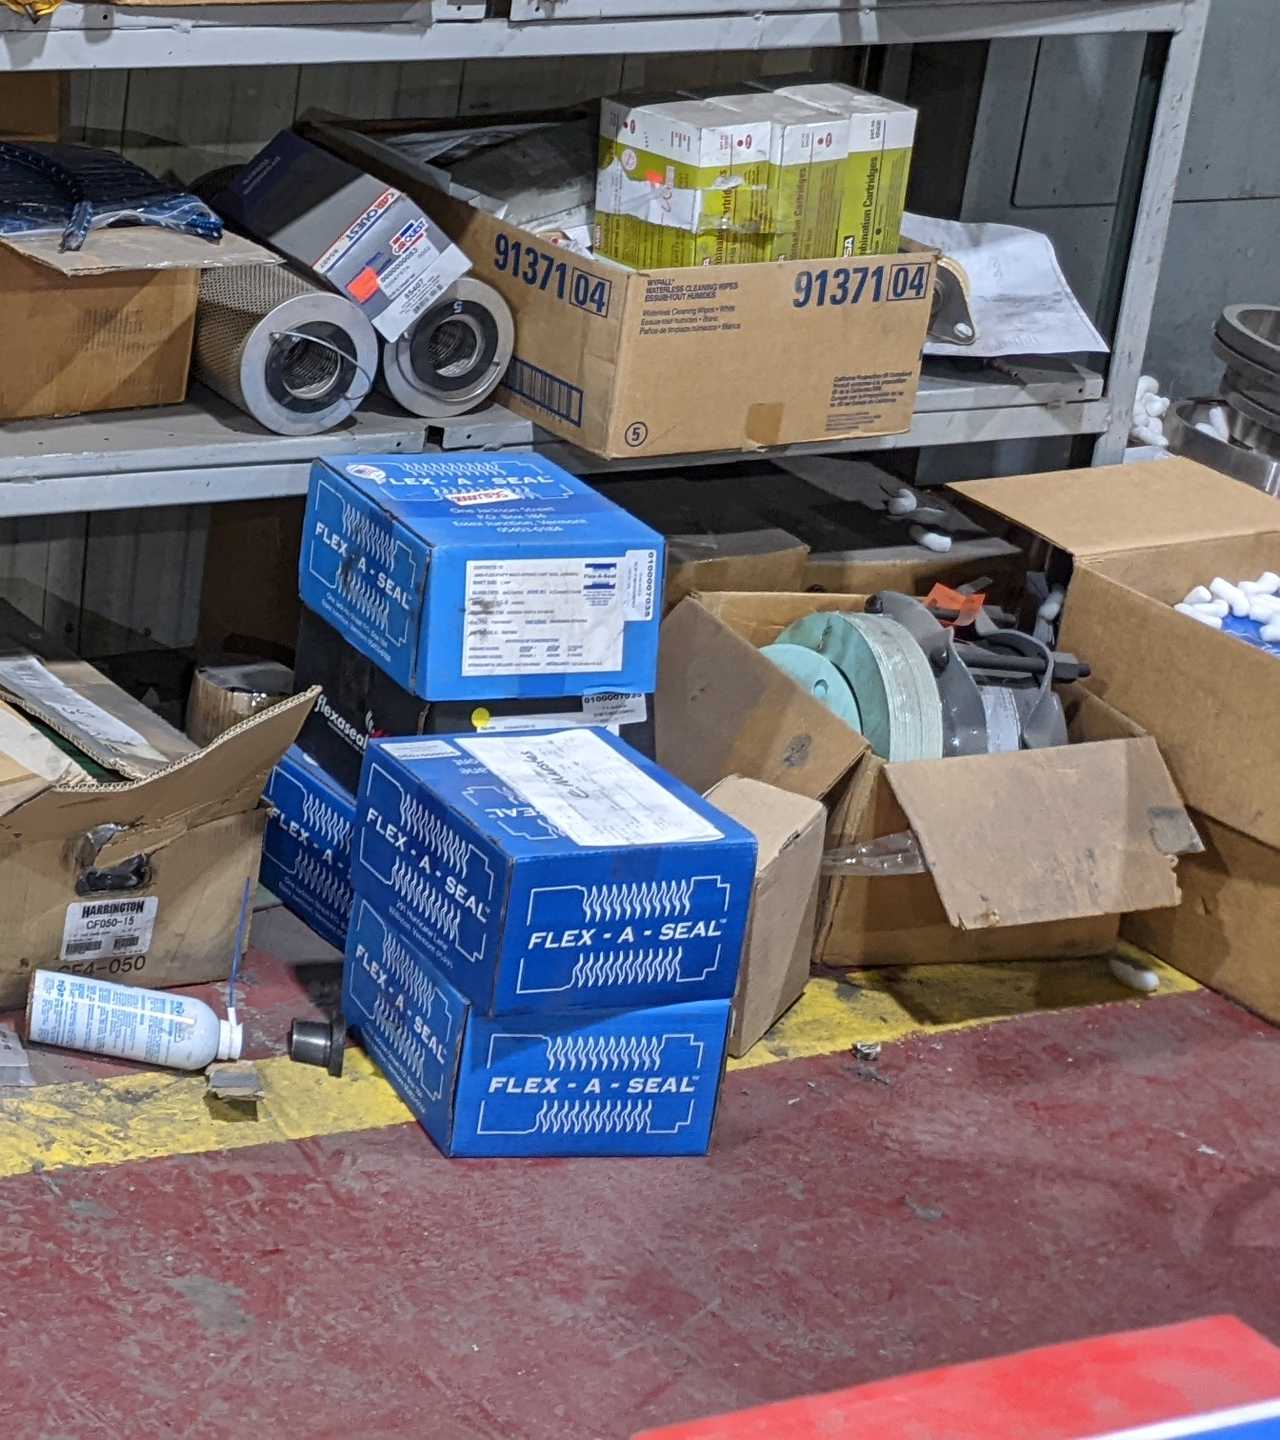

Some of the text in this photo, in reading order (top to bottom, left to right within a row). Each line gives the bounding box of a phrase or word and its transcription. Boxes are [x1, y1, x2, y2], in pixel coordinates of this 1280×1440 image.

[494, 232, 567, 299] 91371
[573, 271, 606, 314] 04
[792, 265, 925, 309] 91371 04
[630, 426, 642, 442] 5
[387, 476, 441, 486] LEX
[493, 475, 554, 486] SEAL
[315, 521, 348, 558] FLEX
[376, 575, 411, 610] SEAL
[366, 808, 409, 849] FLEX
[444, 876, 487, 923] SEAL
[81, 900, 145, 919] HARRINGTON
[528, 921, 722, 950] FLEX A SEAL
[355, 945, 388, 990] FLEX
[413, 1016, 446, 1065] SEAL
[488, 1076, 696, 1094] FLEX A SEAL
